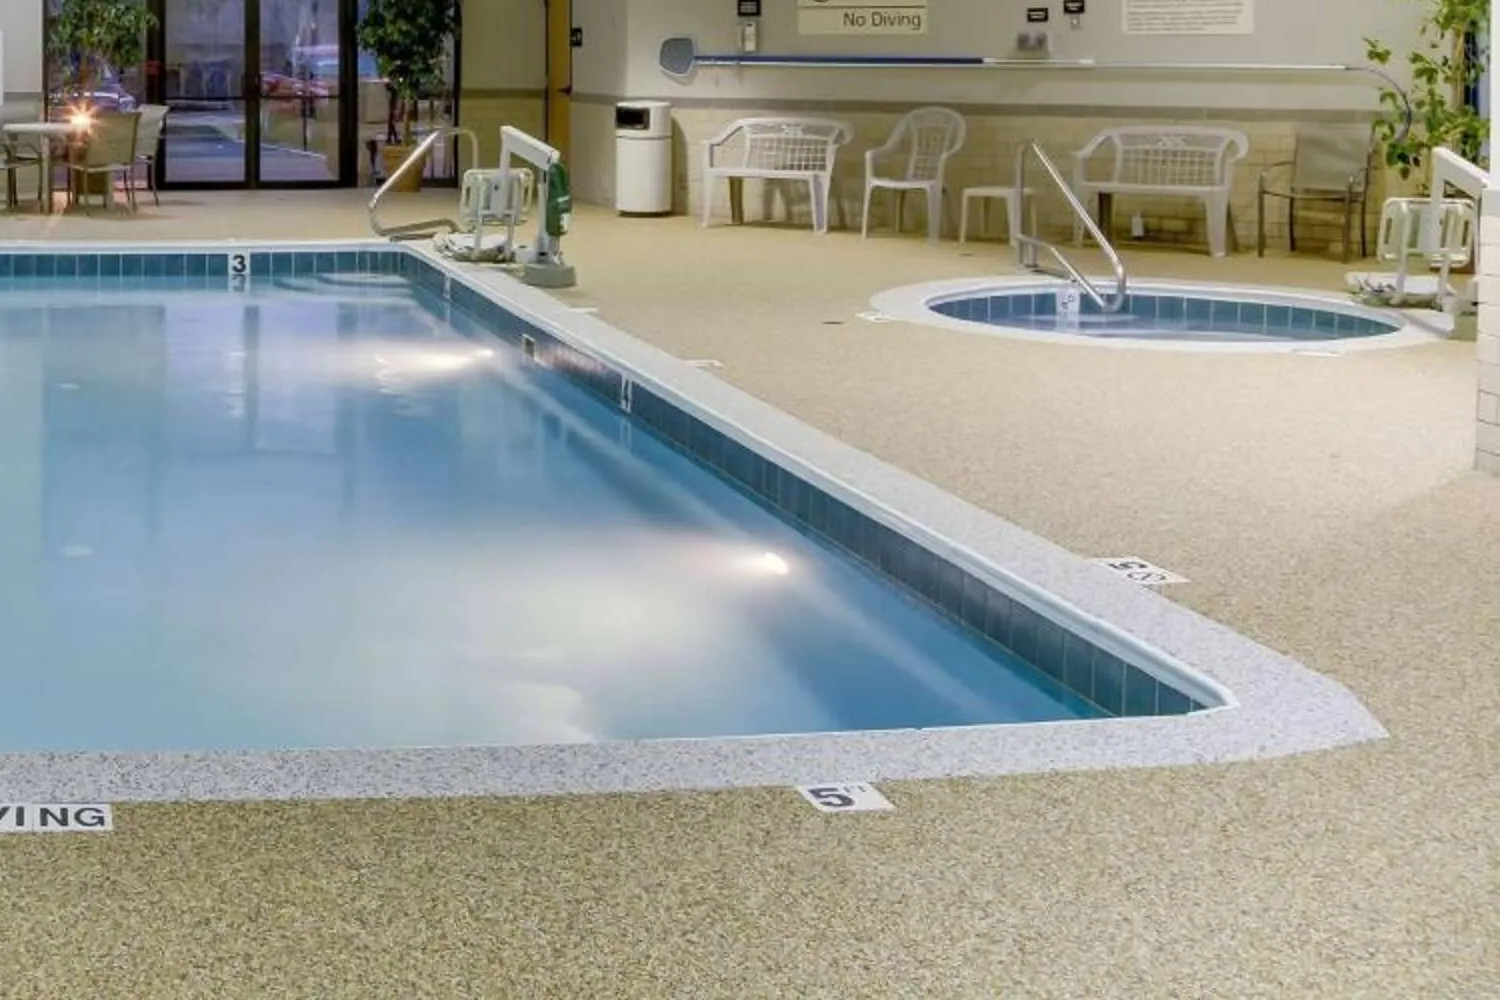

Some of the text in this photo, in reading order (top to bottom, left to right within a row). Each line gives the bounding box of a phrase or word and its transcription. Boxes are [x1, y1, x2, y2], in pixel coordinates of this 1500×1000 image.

[843, 11, 921, 30] No Diving
[232, 254, 246, 273] 3
[808, 787, 855, 807] 5
